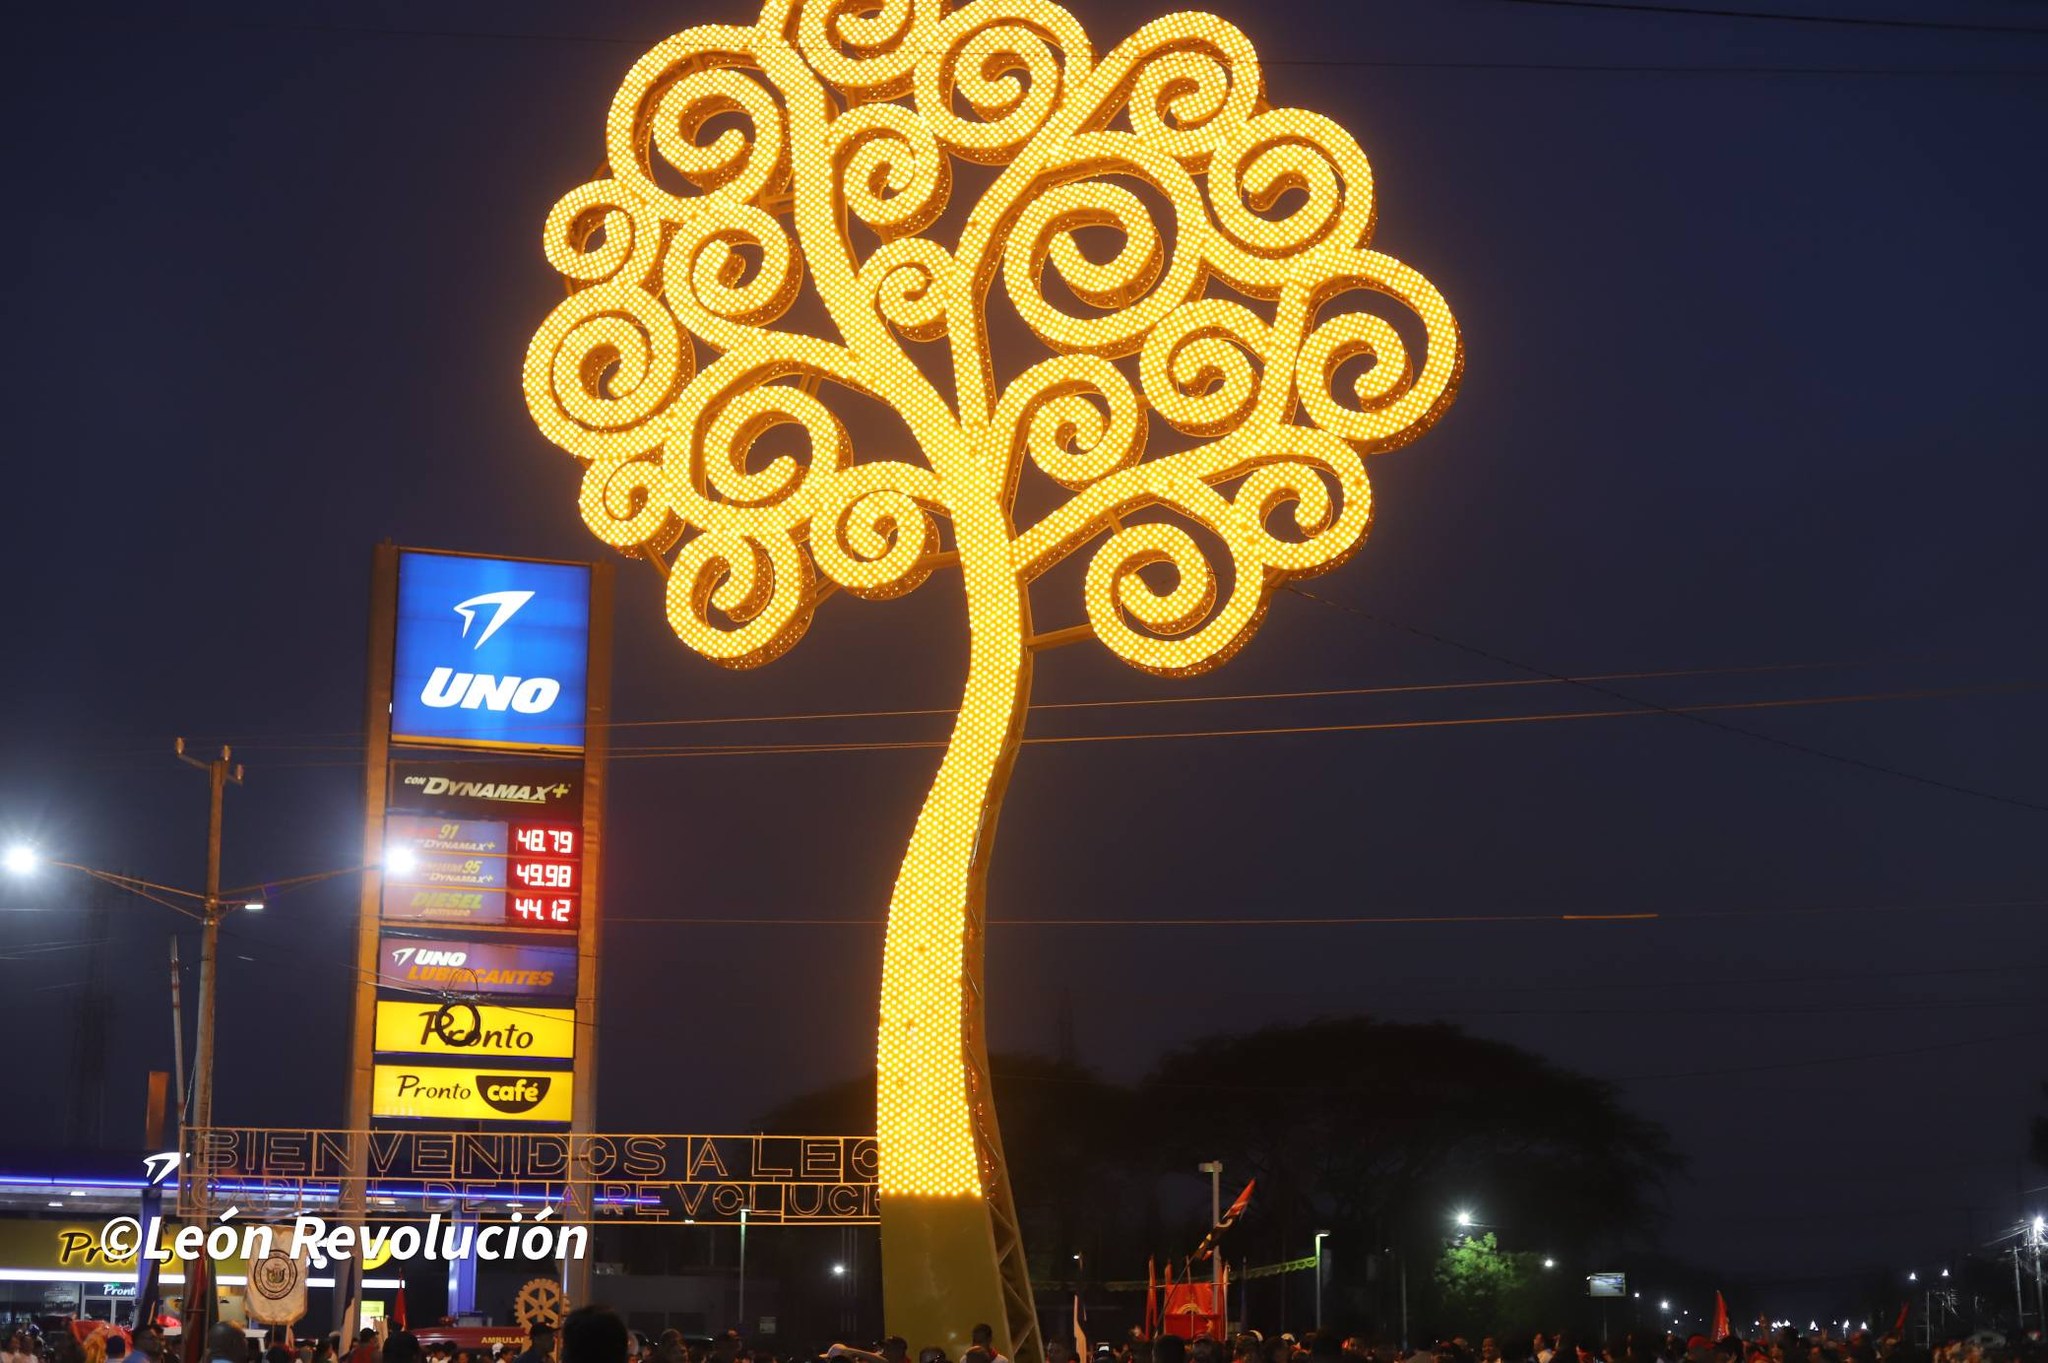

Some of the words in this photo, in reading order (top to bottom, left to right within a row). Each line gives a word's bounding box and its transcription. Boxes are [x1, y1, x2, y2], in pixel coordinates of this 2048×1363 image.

[420, 667, 560, 714] UNO
[439, 823, 460, 839] 91
[462, 860, 482, 874] 95
[411, 892, 483, 909] DIESEL
[414, 949, 467, 967] UNO
[407, 965, 555, 987] LUBRICANTES
[396, 1074, 472, 1100] Pronto
[486, 1078, 539, 1103] café
[197, 1130, 667, 1177] BIENVENIDOS
[689, 1138, 728, 1177] A
[752, 1137, 879, 1178] LEO
[422, 1180, 497, 1213] DE
[513, 1182, 587, 1215] LA
[602, 1182, 881, 1217] REVOLUCI
[481, 1336, 525, 1344] AMBULA
